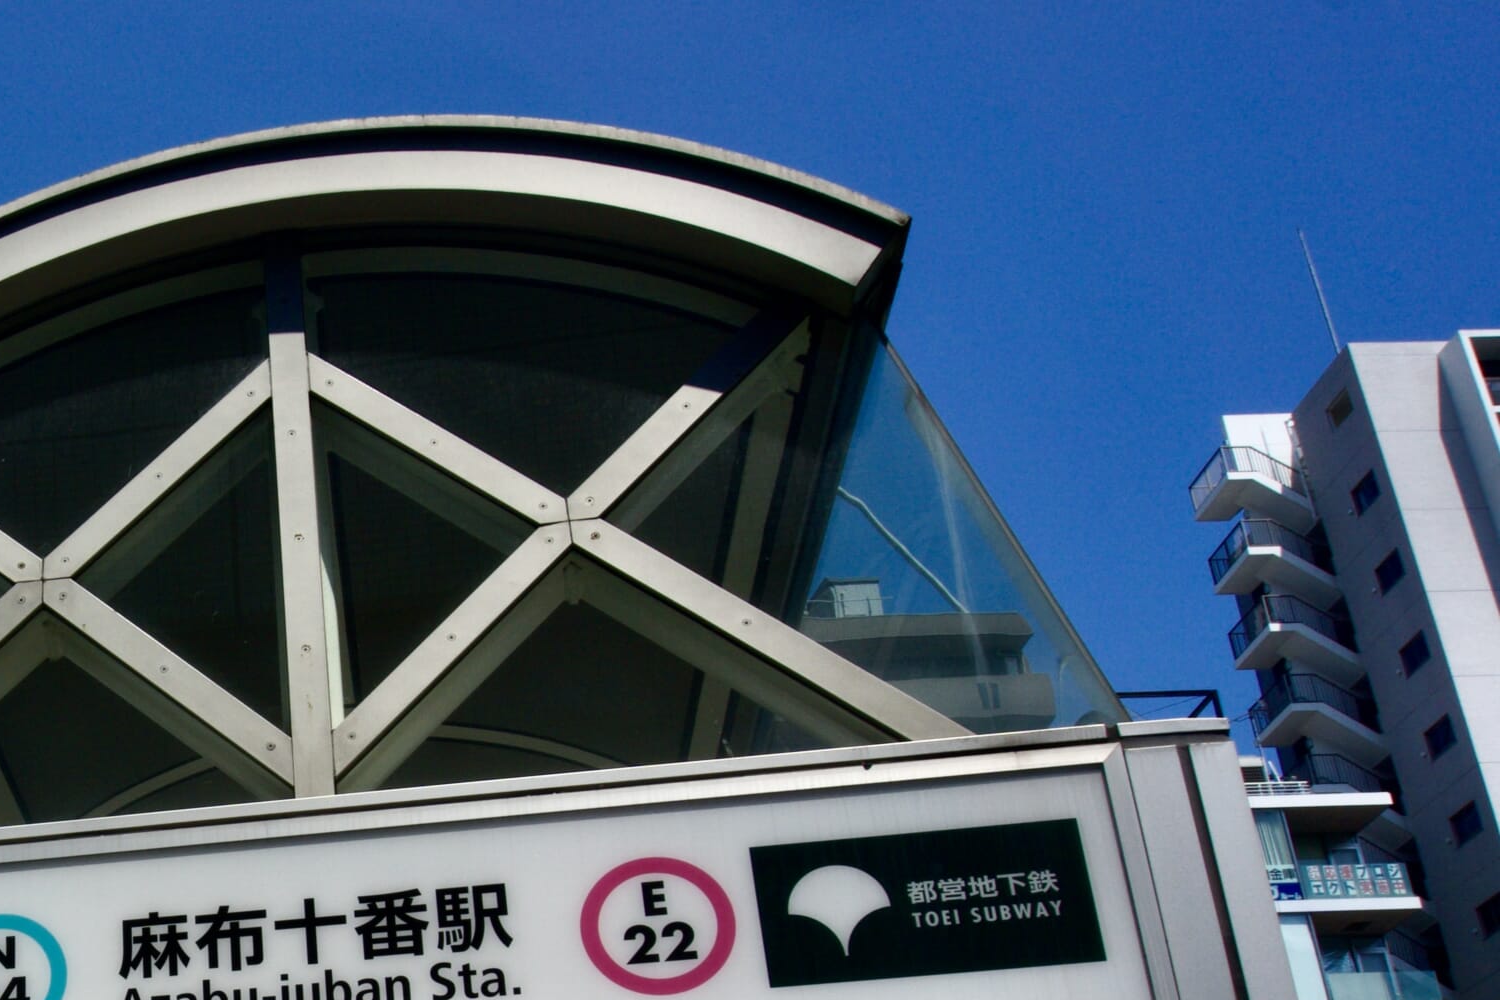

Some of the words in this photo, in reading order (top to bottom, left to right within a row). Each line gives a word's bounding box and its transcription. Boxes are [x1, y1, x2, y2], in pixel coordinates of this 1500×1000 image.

[641, 880, 667, 916] E
[906, 869, 1060, 904] 都営地下鉄
[118, 882, 514, 980] 麻布十番駅
[911, 909, 961, 928] TOEI
[971, 900, 1063, 923] SUBWAY
[623, 921, 699, 965] 22
